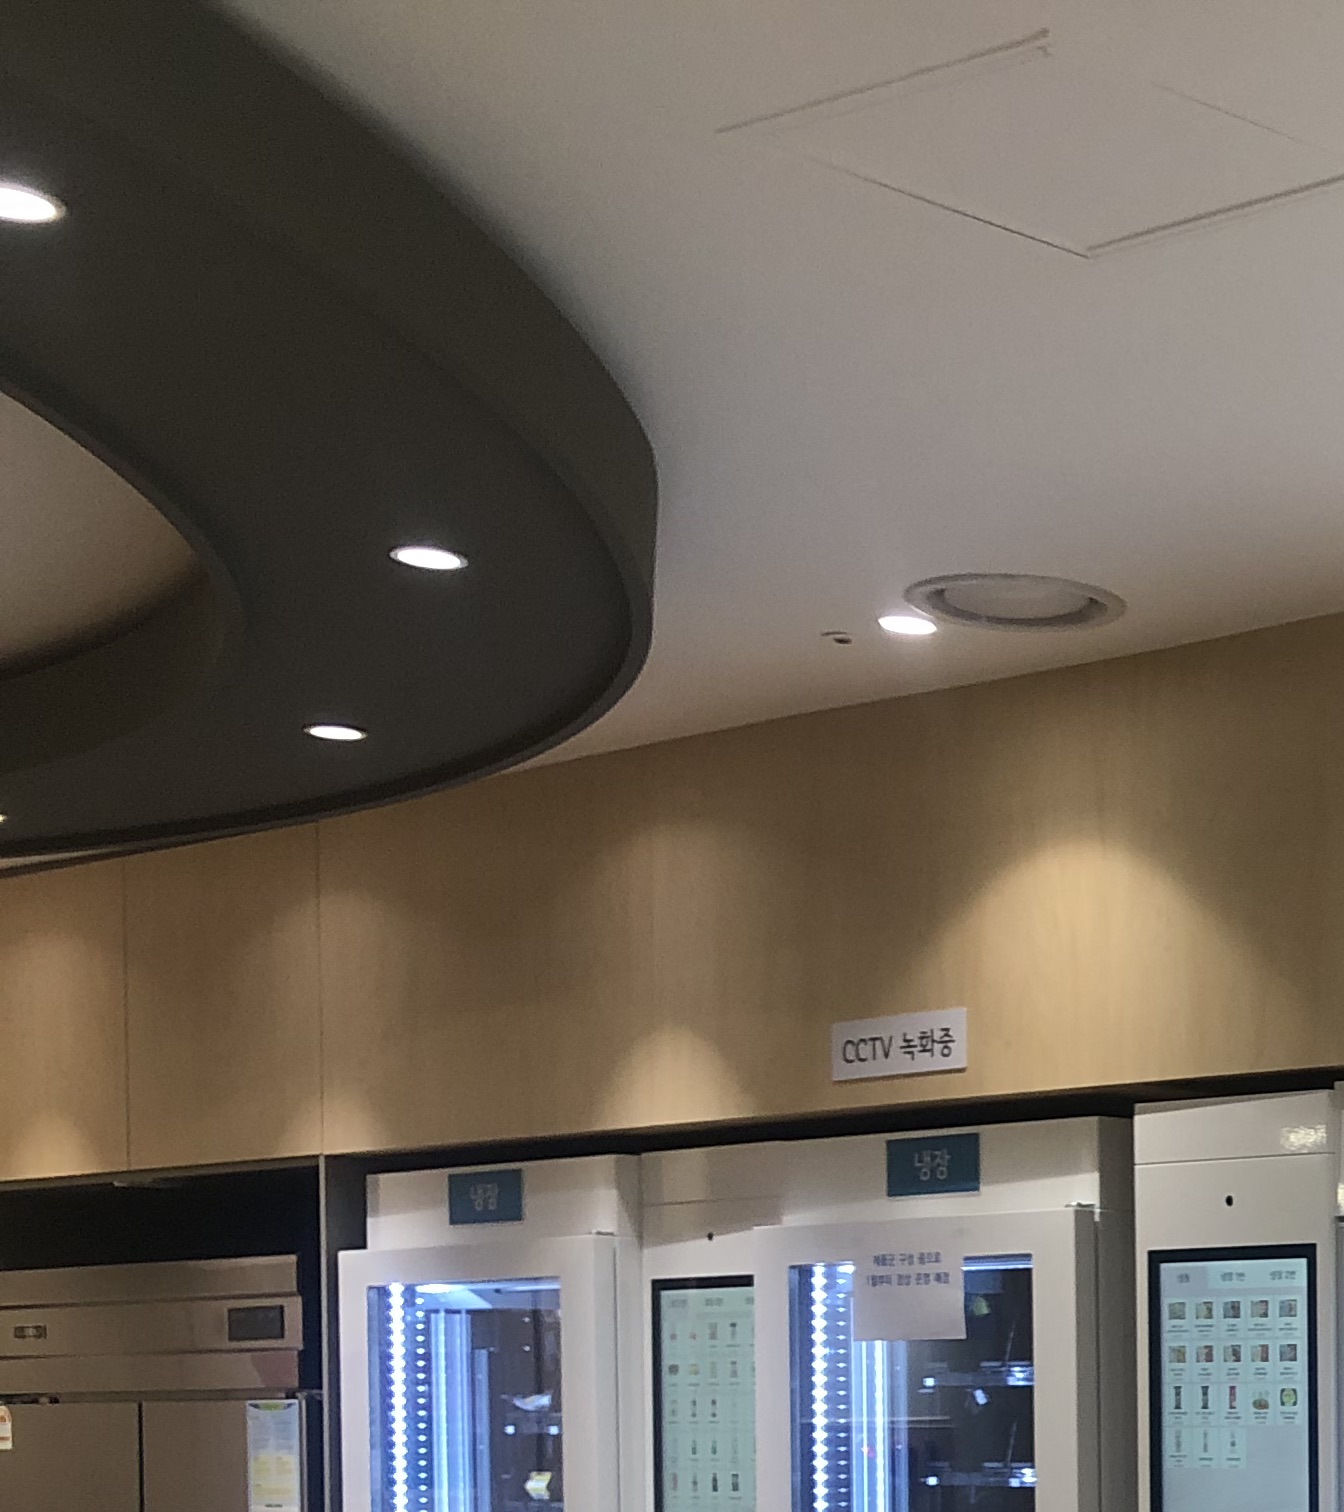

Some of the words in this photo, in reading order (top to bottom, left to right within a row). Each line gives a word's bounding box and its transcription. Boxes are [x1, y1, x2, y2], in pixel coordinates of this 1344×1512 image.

[842, 1035, 893, 1065] CCTV
[899, 1027, 956, 1062] 녹화중
[912, 1149, 952, 1181] 냉장
